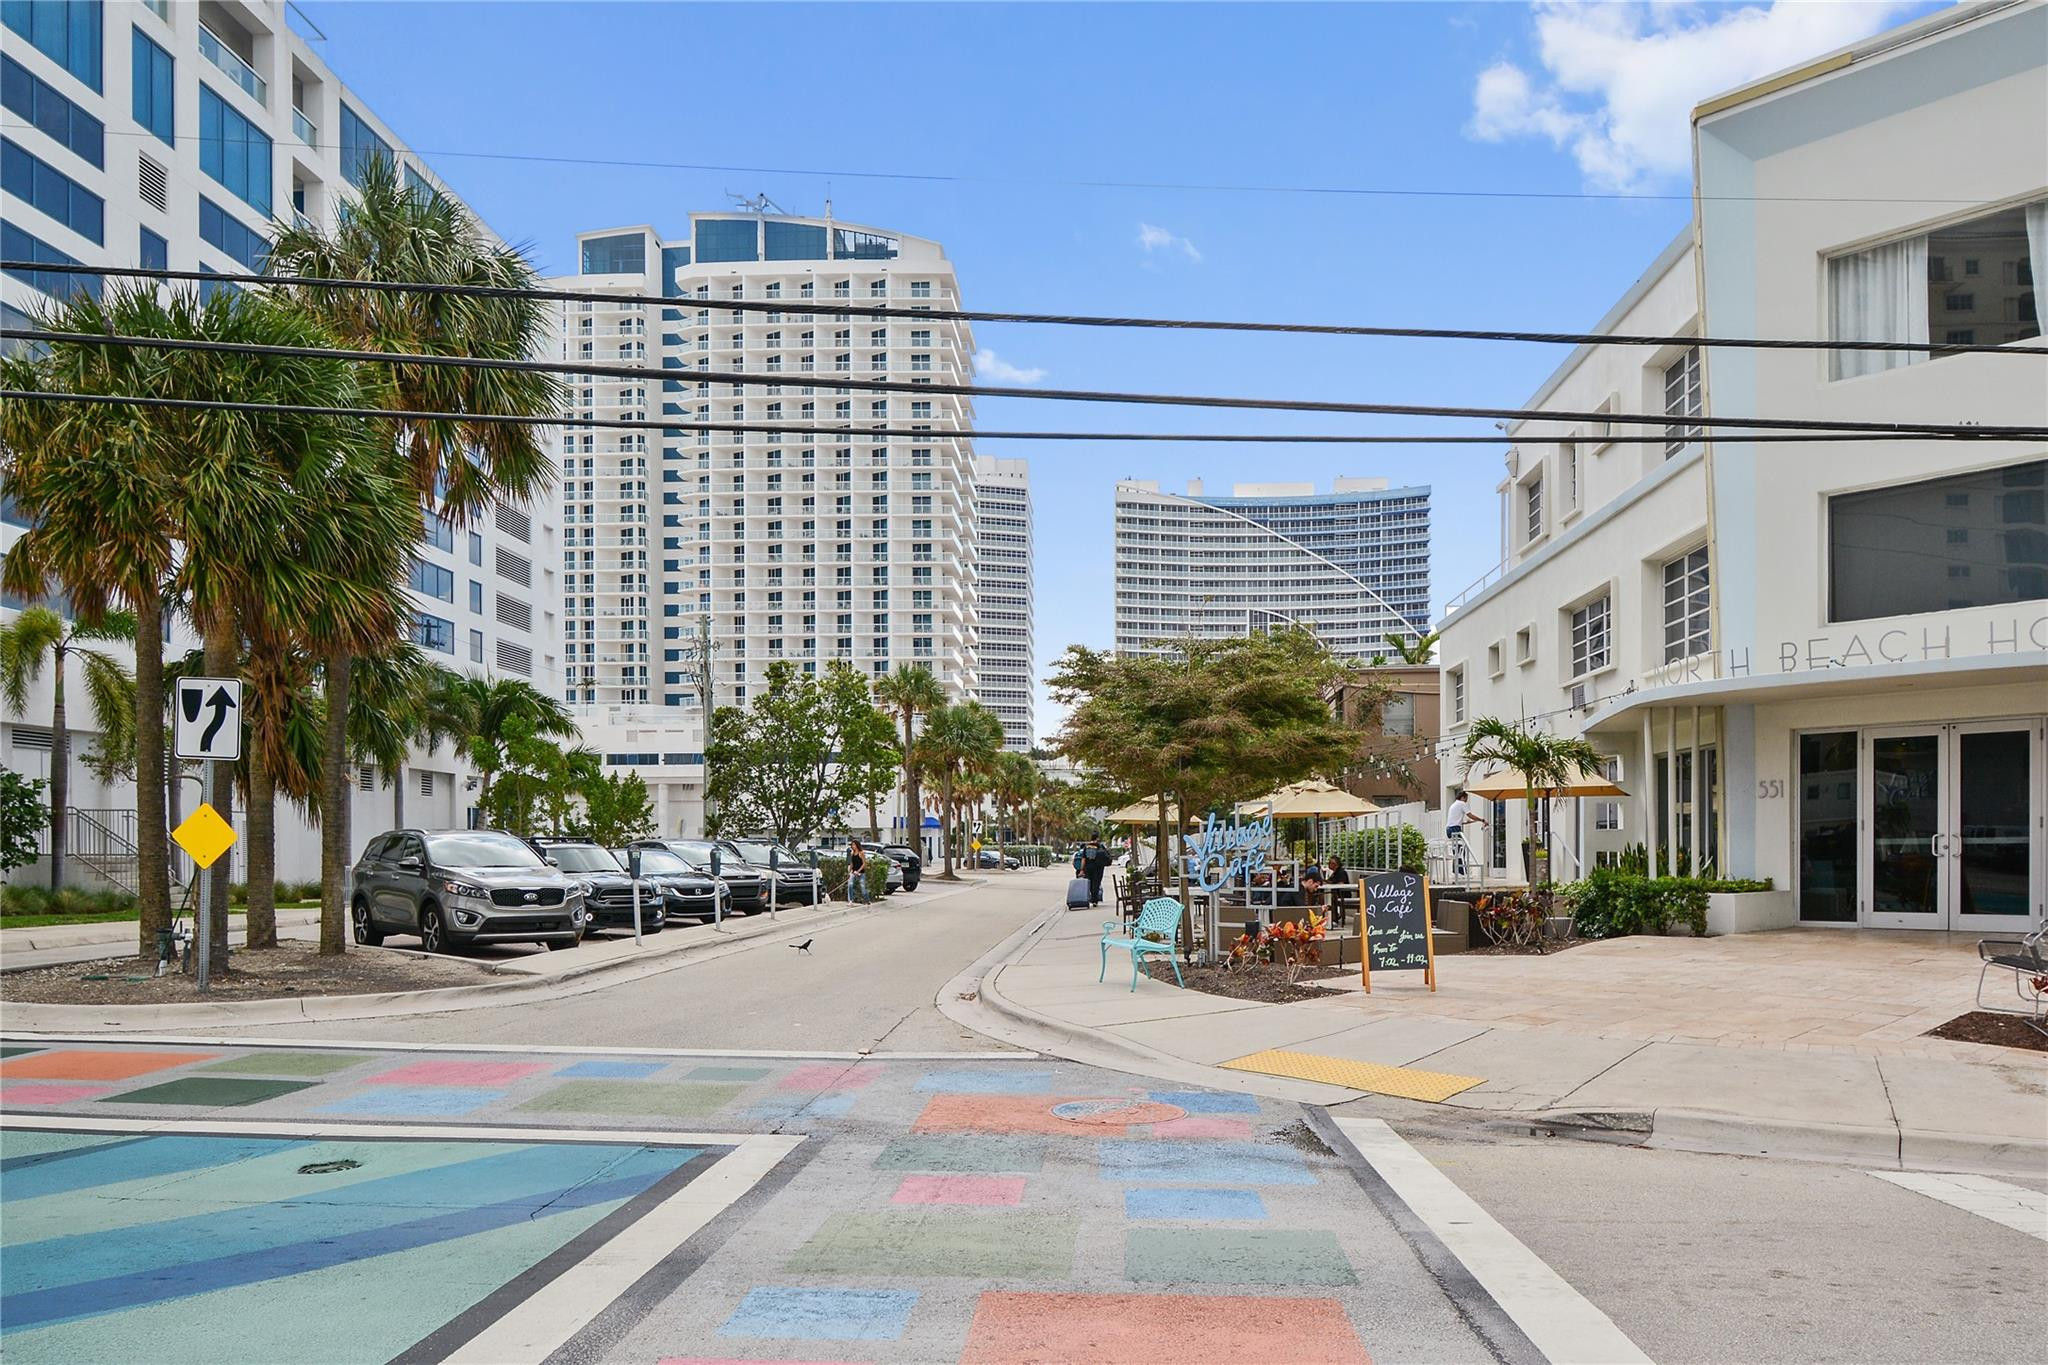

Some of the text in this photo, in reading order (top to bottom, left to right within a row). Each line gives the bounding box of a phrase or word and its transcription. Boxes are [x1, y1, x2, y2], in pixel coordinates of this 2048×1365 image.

[1653, 647, 1750, 689] NORTH
[1779, 625, 1951, 673] BEACH
[1759, 779, 1784, 800] 551
[1183, 812, 1273, 861] Village
[1369, 884, 1414, 904] Village
